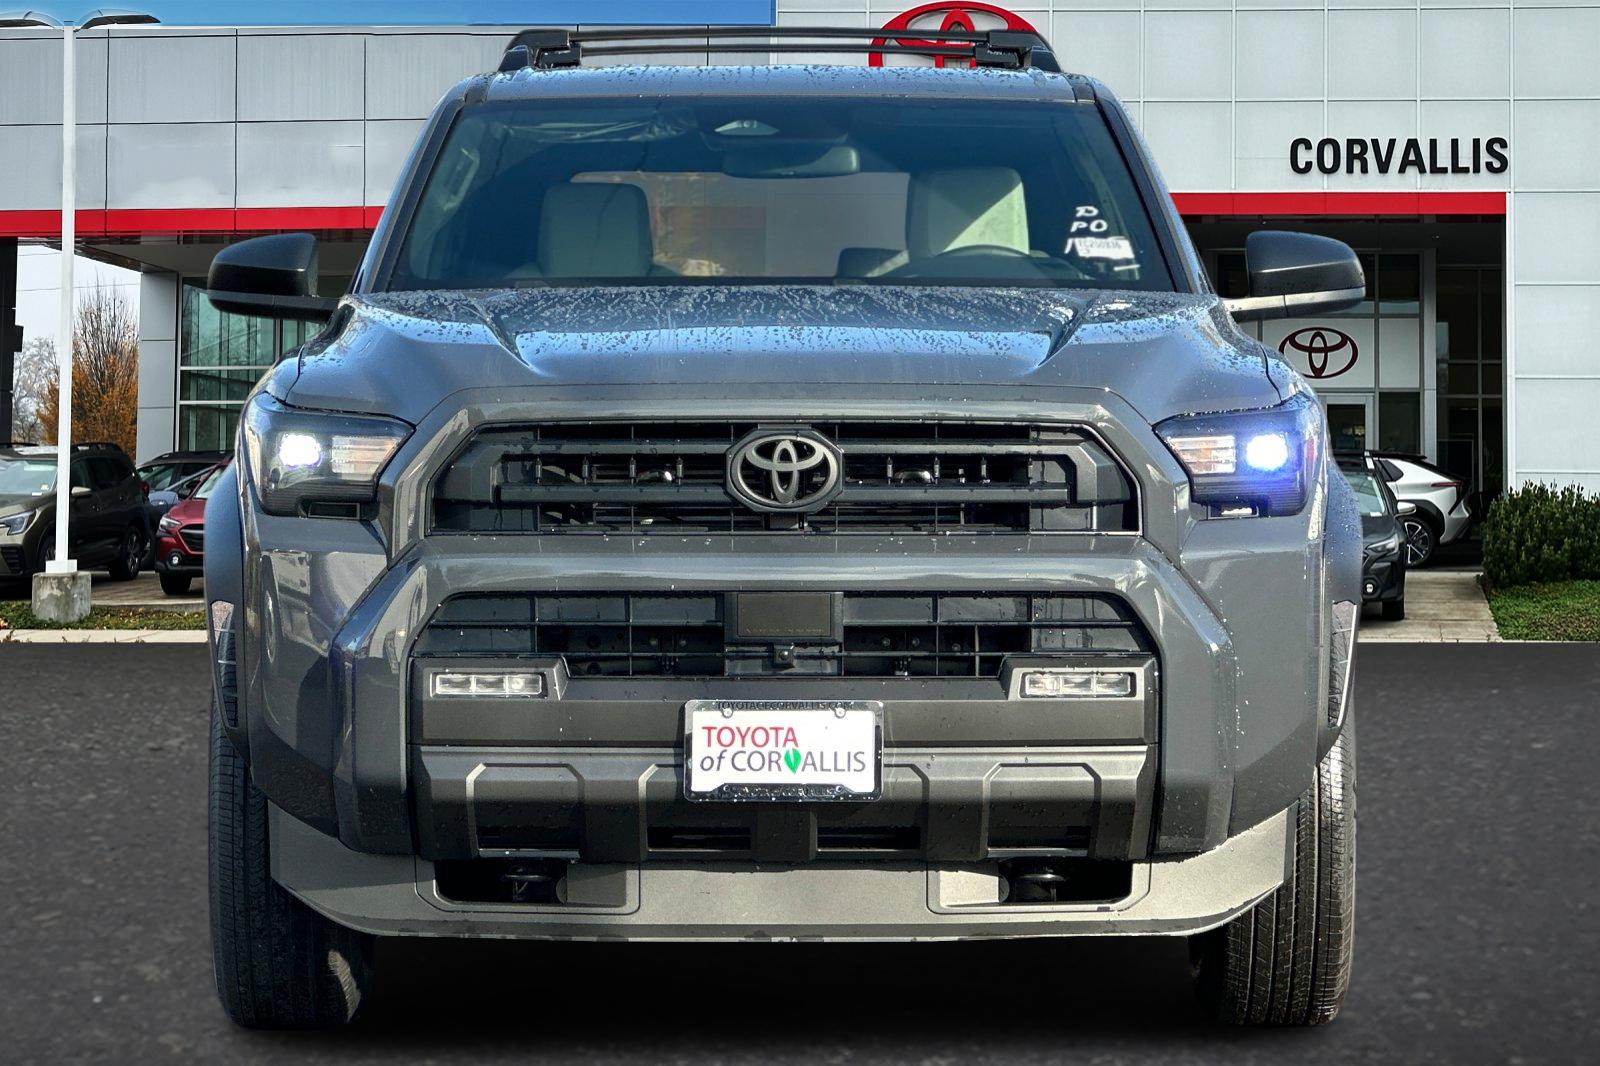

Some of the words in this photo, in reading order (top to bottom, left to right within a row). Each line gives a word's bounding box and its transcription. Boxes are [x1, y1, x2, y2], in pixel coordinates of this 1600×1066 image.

[1289, 137, 1509, 175] CORVALLIS
[701, 725, 799, 748] TOYOTA
[700, 749, 727, 772] of
